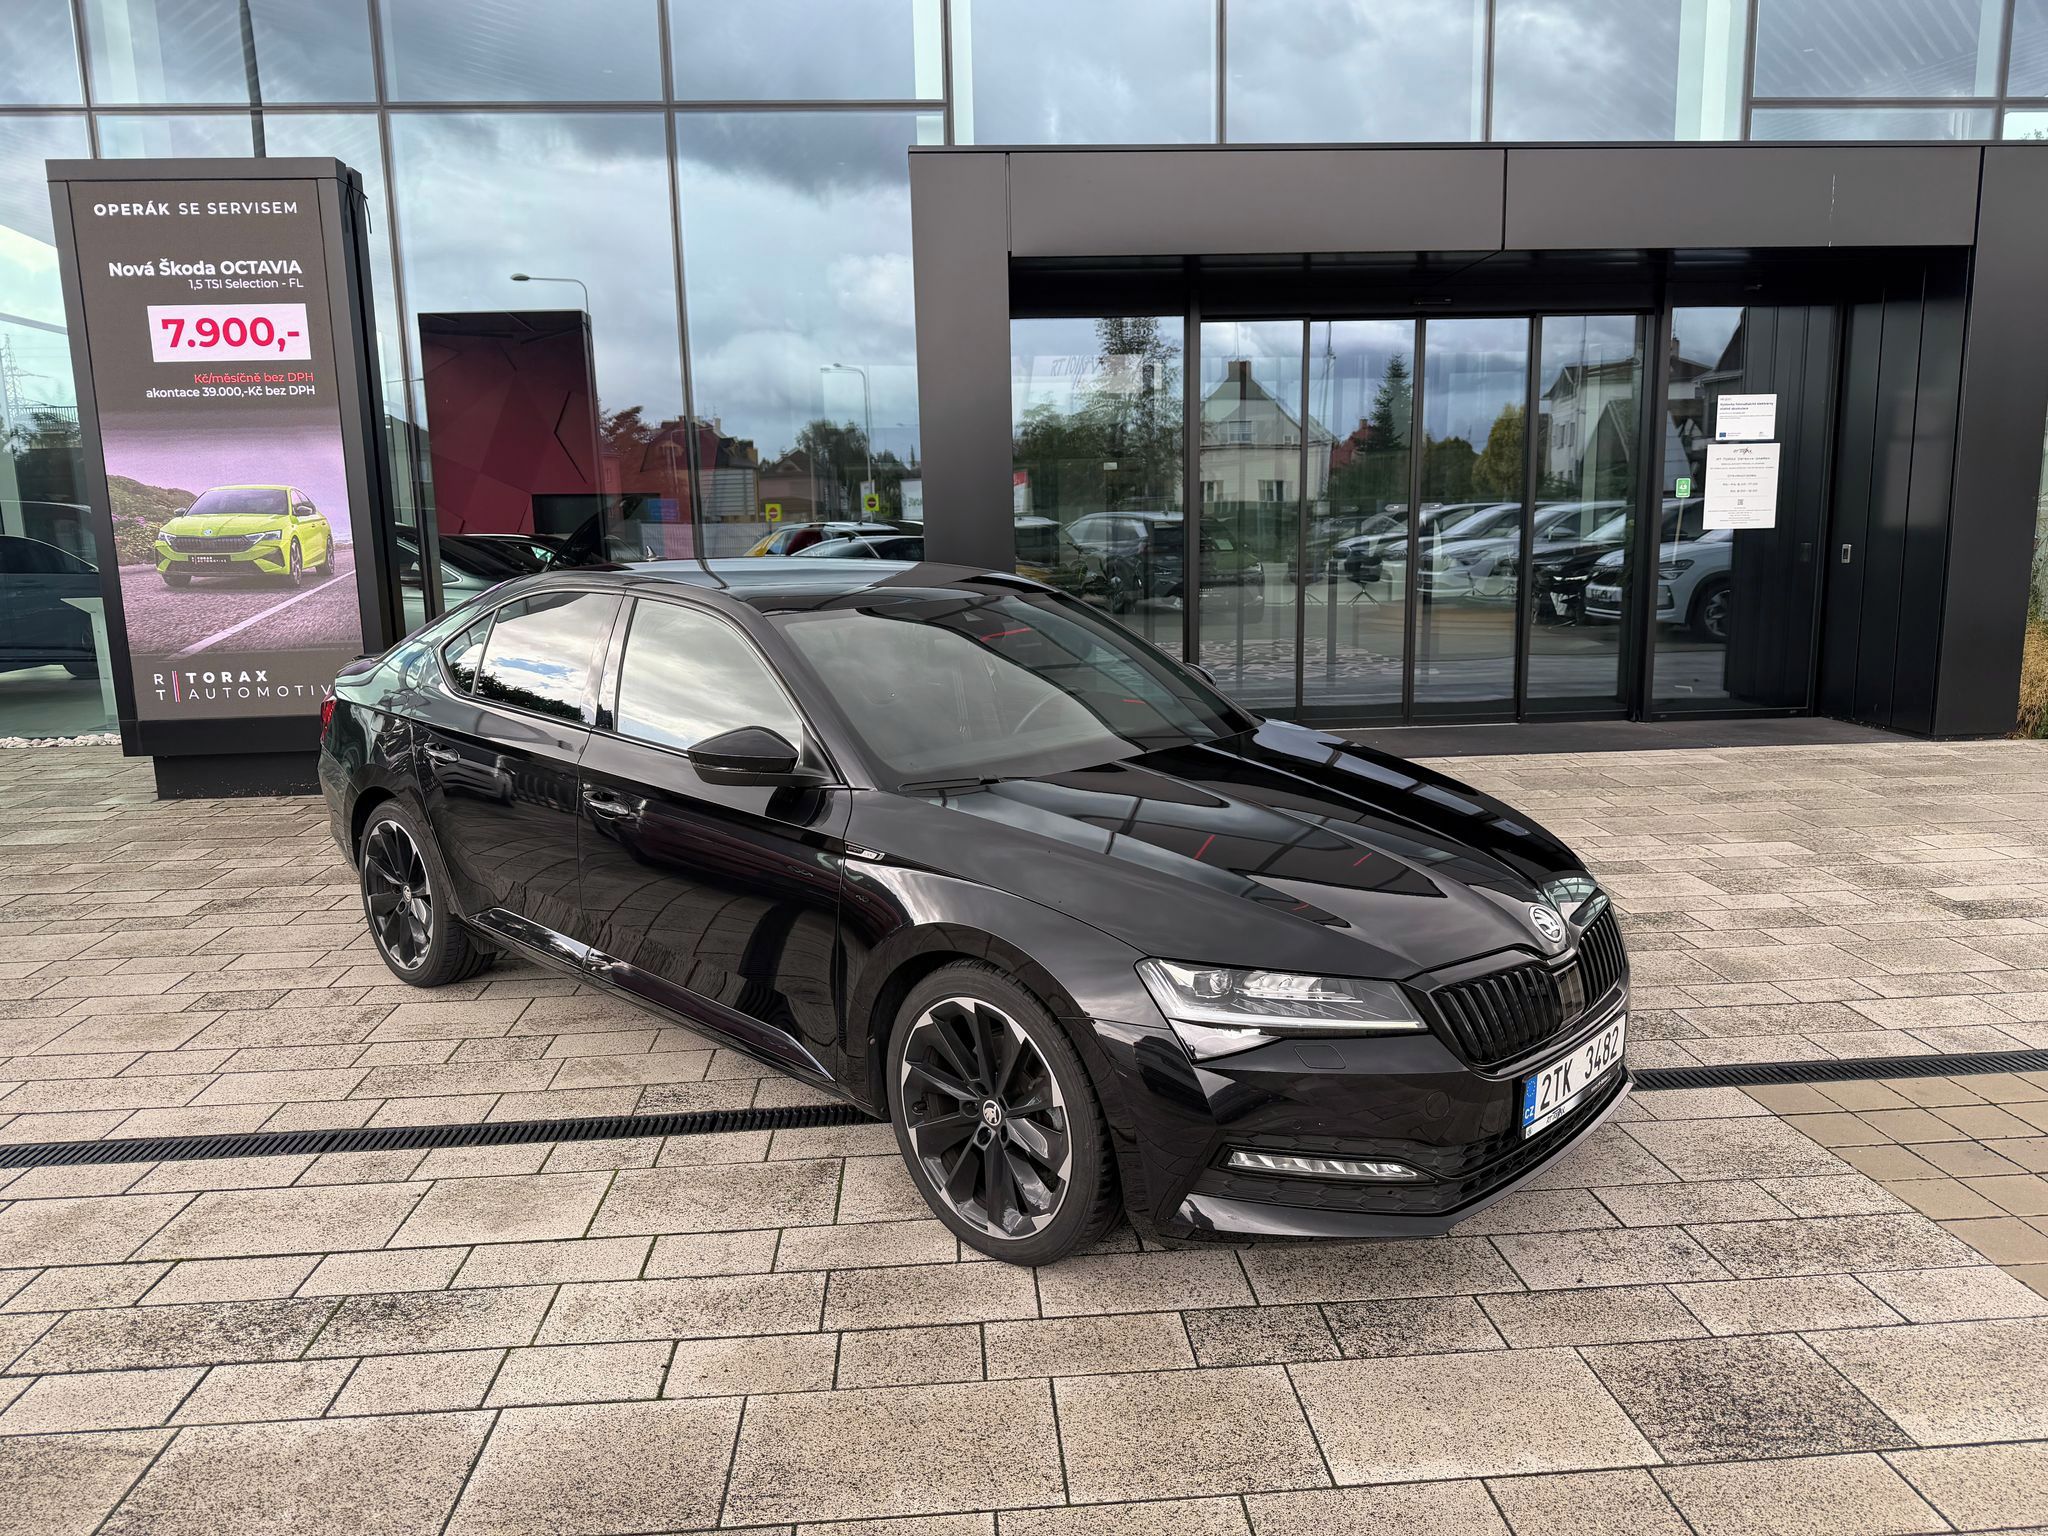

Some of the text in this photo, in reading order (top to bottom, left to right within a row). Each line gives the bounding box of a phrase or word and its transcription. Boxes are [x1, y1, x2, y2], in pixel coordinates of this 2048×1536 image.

[93, 201, 298, 216] OPERÁK SE SERVISEM
[108, 258, 303, 277] Nová Škoda OCTAVIA
[188, 280, 203, 290] 1,5
[204, 279, 222, 289] TSI
[225, 278, 279, 289] Selection
[289, 278, 304, 288] FL
[161, 317, 300, 352] 7.900,-
[194, 372, 314, 384] Kč/měsíčně bez DPH
[146, 387, 200, 398] akontace
[265, 386, 287, 396] bez
[289, 385, 316, 396] DPH
[154, 670, 268, 685] R TORAX
[156, 684, 331, 700] T AUTOMOTIV
[1540, 1026, 1618, 1111] 2TK 3482
[1524, 1106, 1535, 1119] CZ
